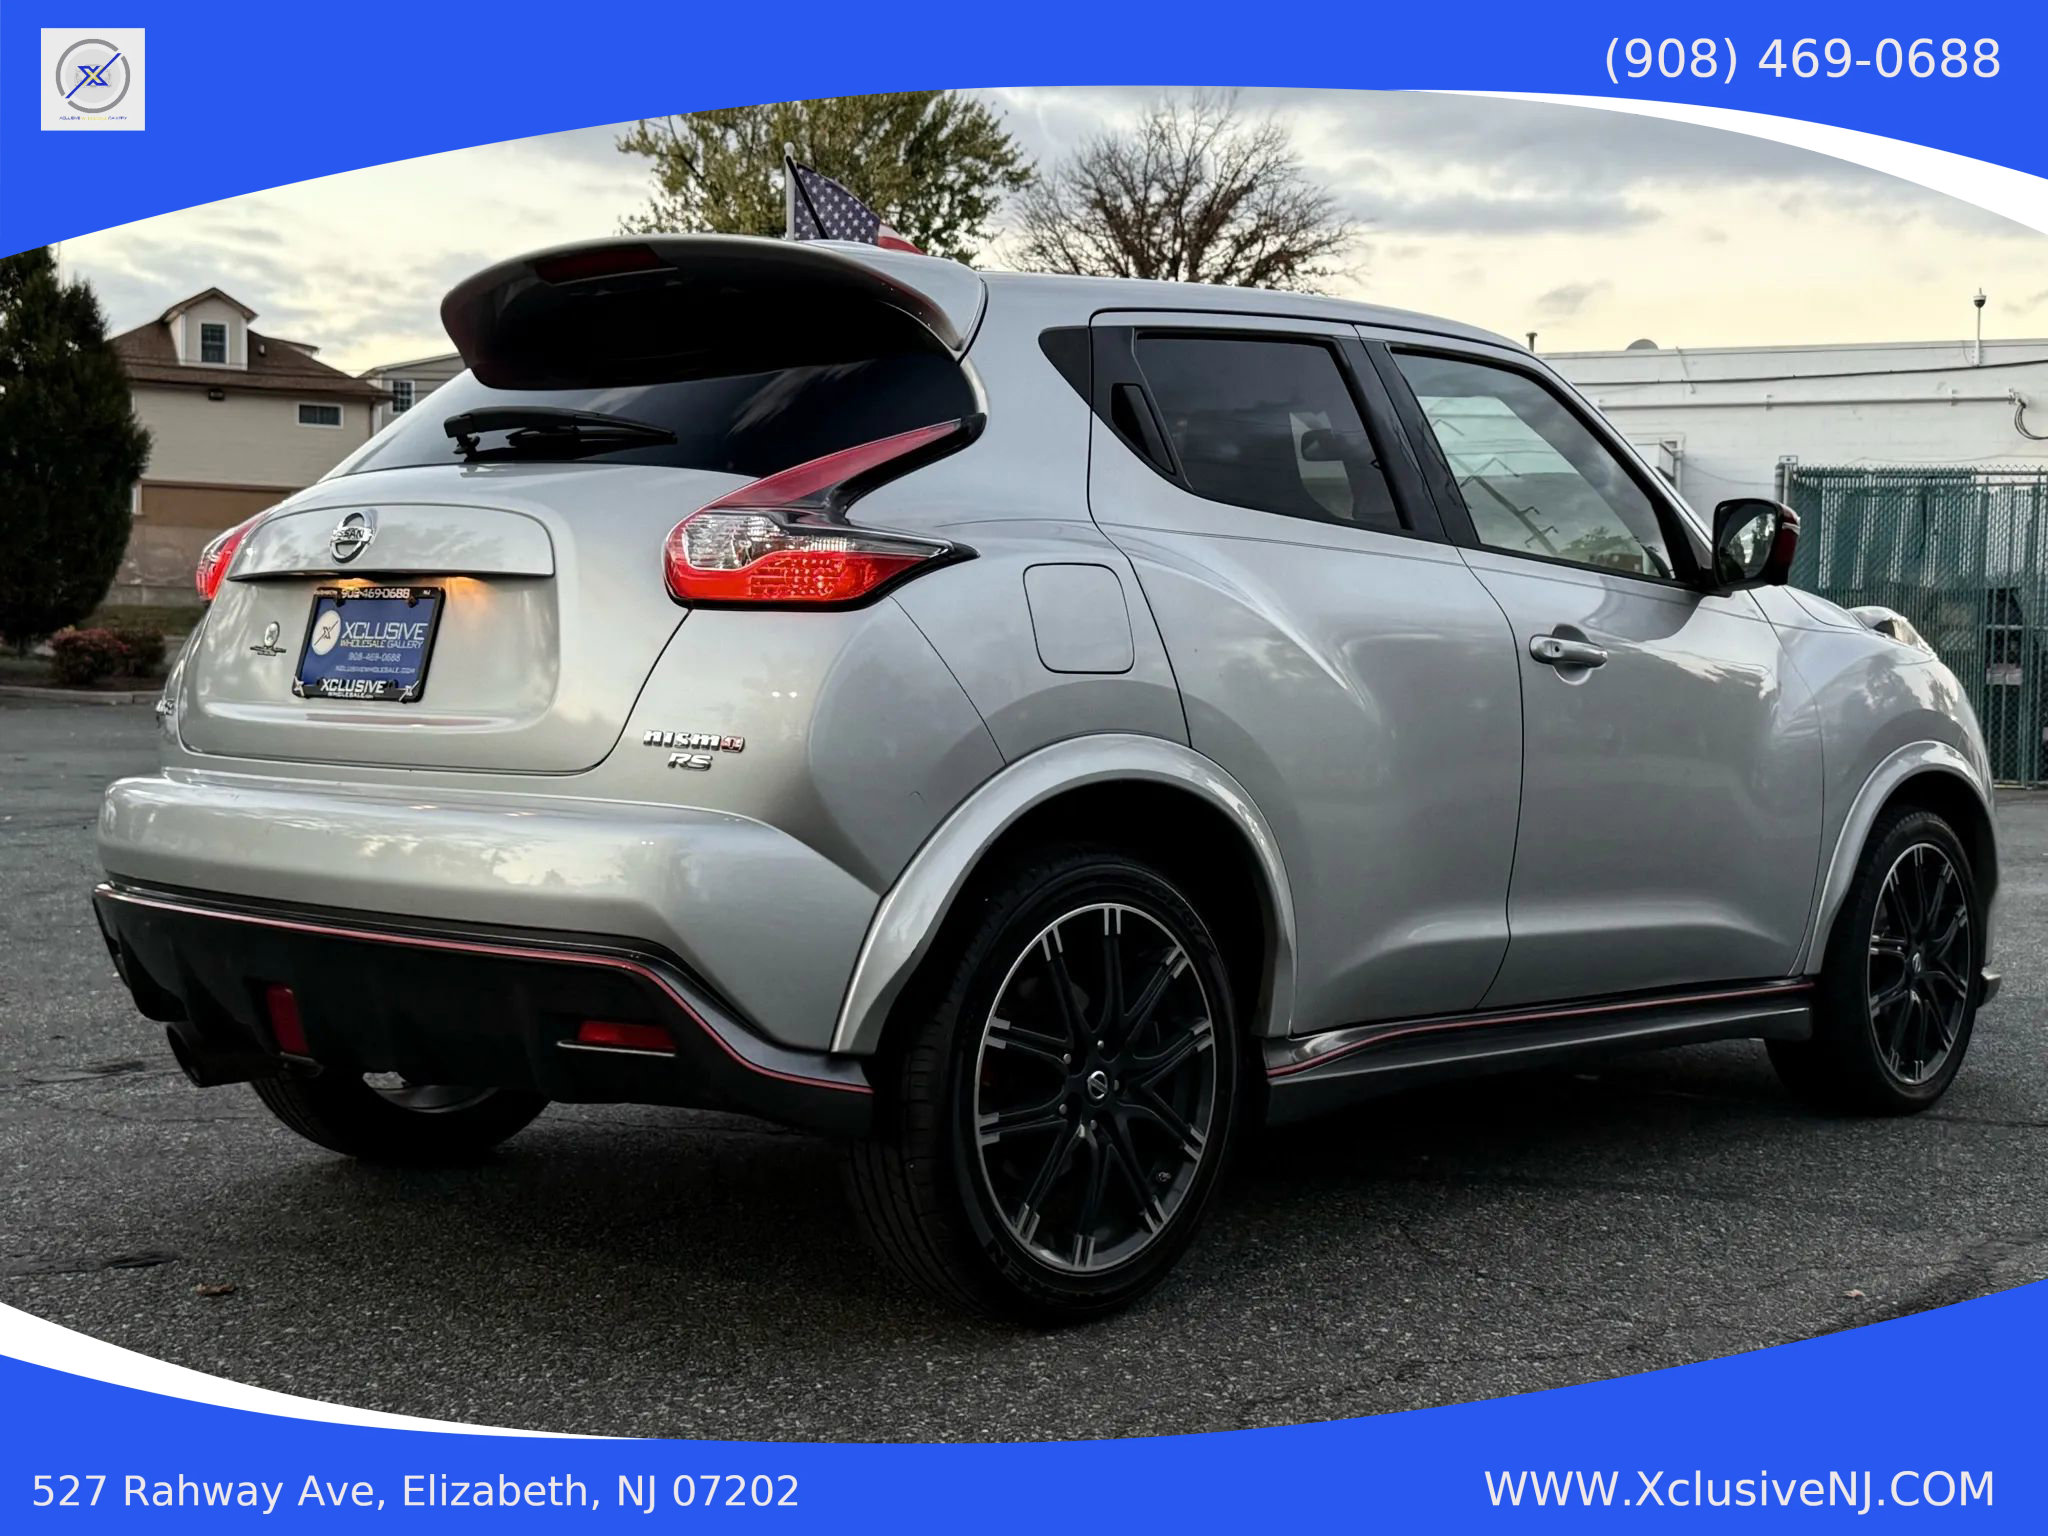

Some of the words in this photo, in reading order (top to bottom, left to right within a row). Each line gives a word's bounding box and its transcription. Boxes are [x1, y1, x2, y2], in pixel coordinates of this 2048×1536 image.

[333, 527, 365, 540] SSAN
[341, 622, 428, 641] XCLUSIVE
[340, 639, 385, 648] WHOLESALE
[386, 640, 424, 649] GALLERY
[320, 678, 387, 694] XCLUSIVE
[667, 751, 714, 772] RS
